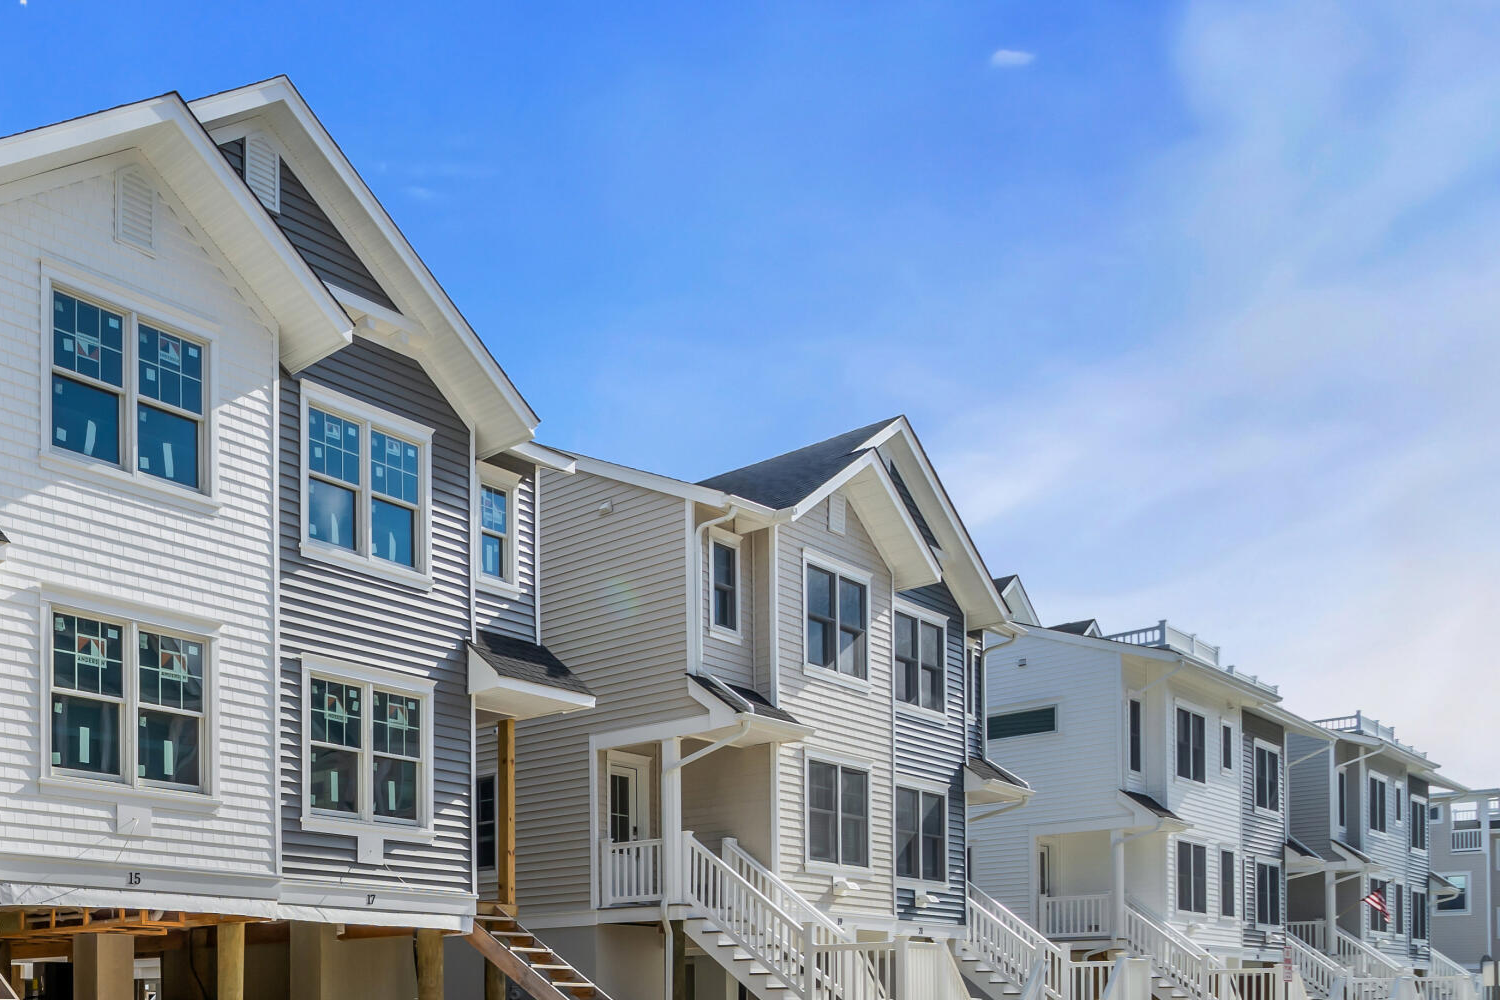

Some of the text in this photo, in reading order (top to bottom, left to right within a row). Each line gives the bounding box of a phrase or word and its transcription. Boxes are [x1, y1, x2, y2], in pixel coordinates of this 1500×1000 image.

[77, 655, 106, 666] ANDERSN
[161, 671, 187, 680] ANDERSN
[128, 872, 141, 885] 15
[367, 894, 376, 905] 17
